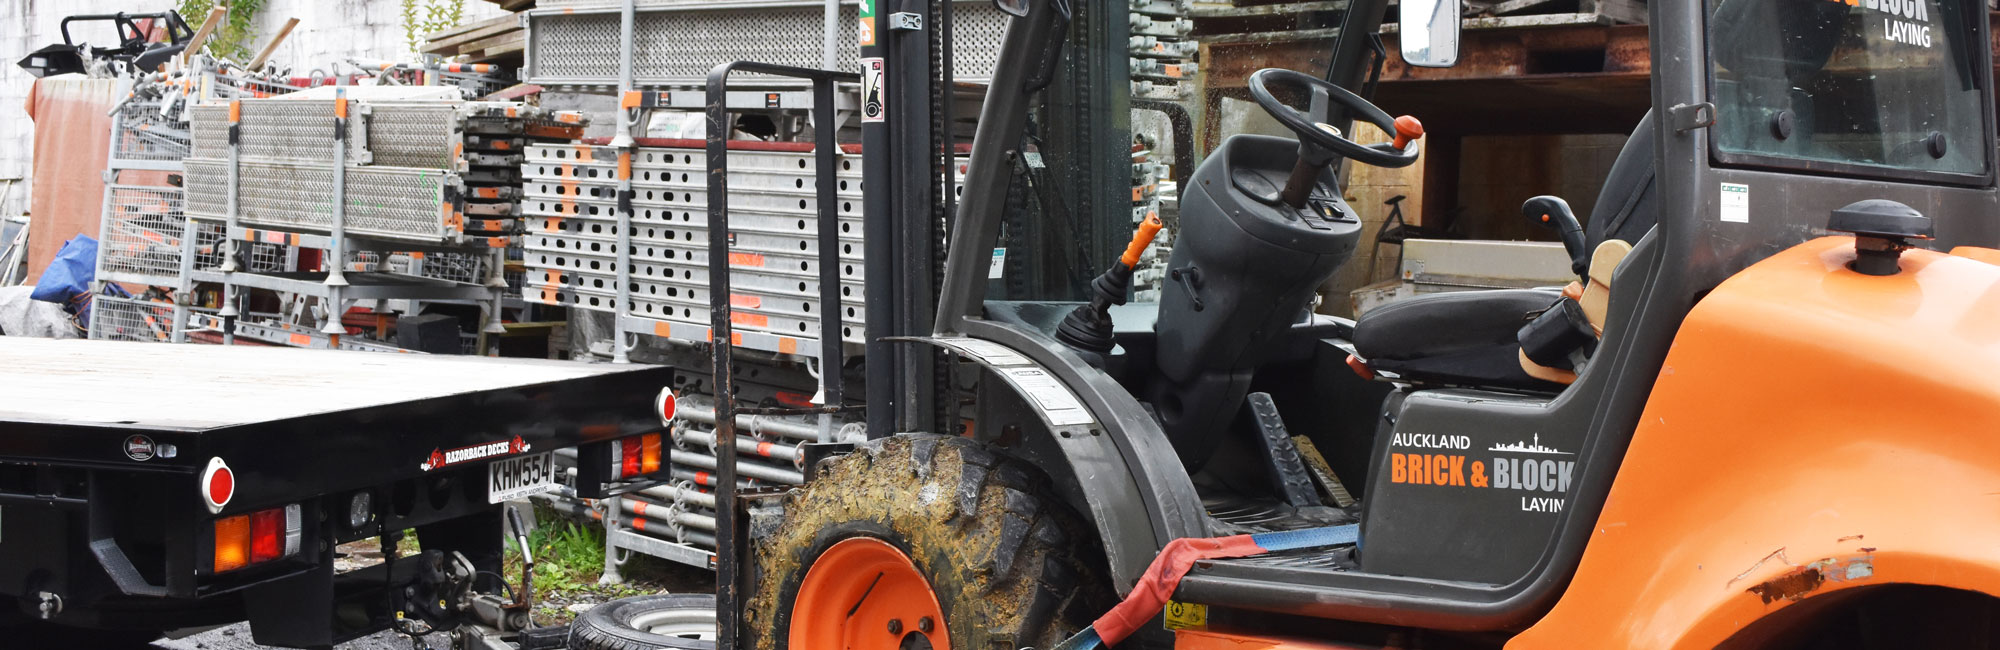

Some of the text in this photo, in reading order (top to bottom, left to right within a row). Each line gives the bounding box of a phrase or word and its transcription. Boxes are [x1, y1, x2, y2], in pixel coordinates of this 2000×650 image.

[1884, 18, 1931, 48] LAYING
[445, 441, 509, 464] RAZORBACK DECKS
[1392, 433, 1471, 450] AUCKLAND
[493, 454, 550, 492] KHM554
[1391, 453, 1575, 492] BRICK & BLOCK
[1521, 497, 1565, 513] LAYIN
